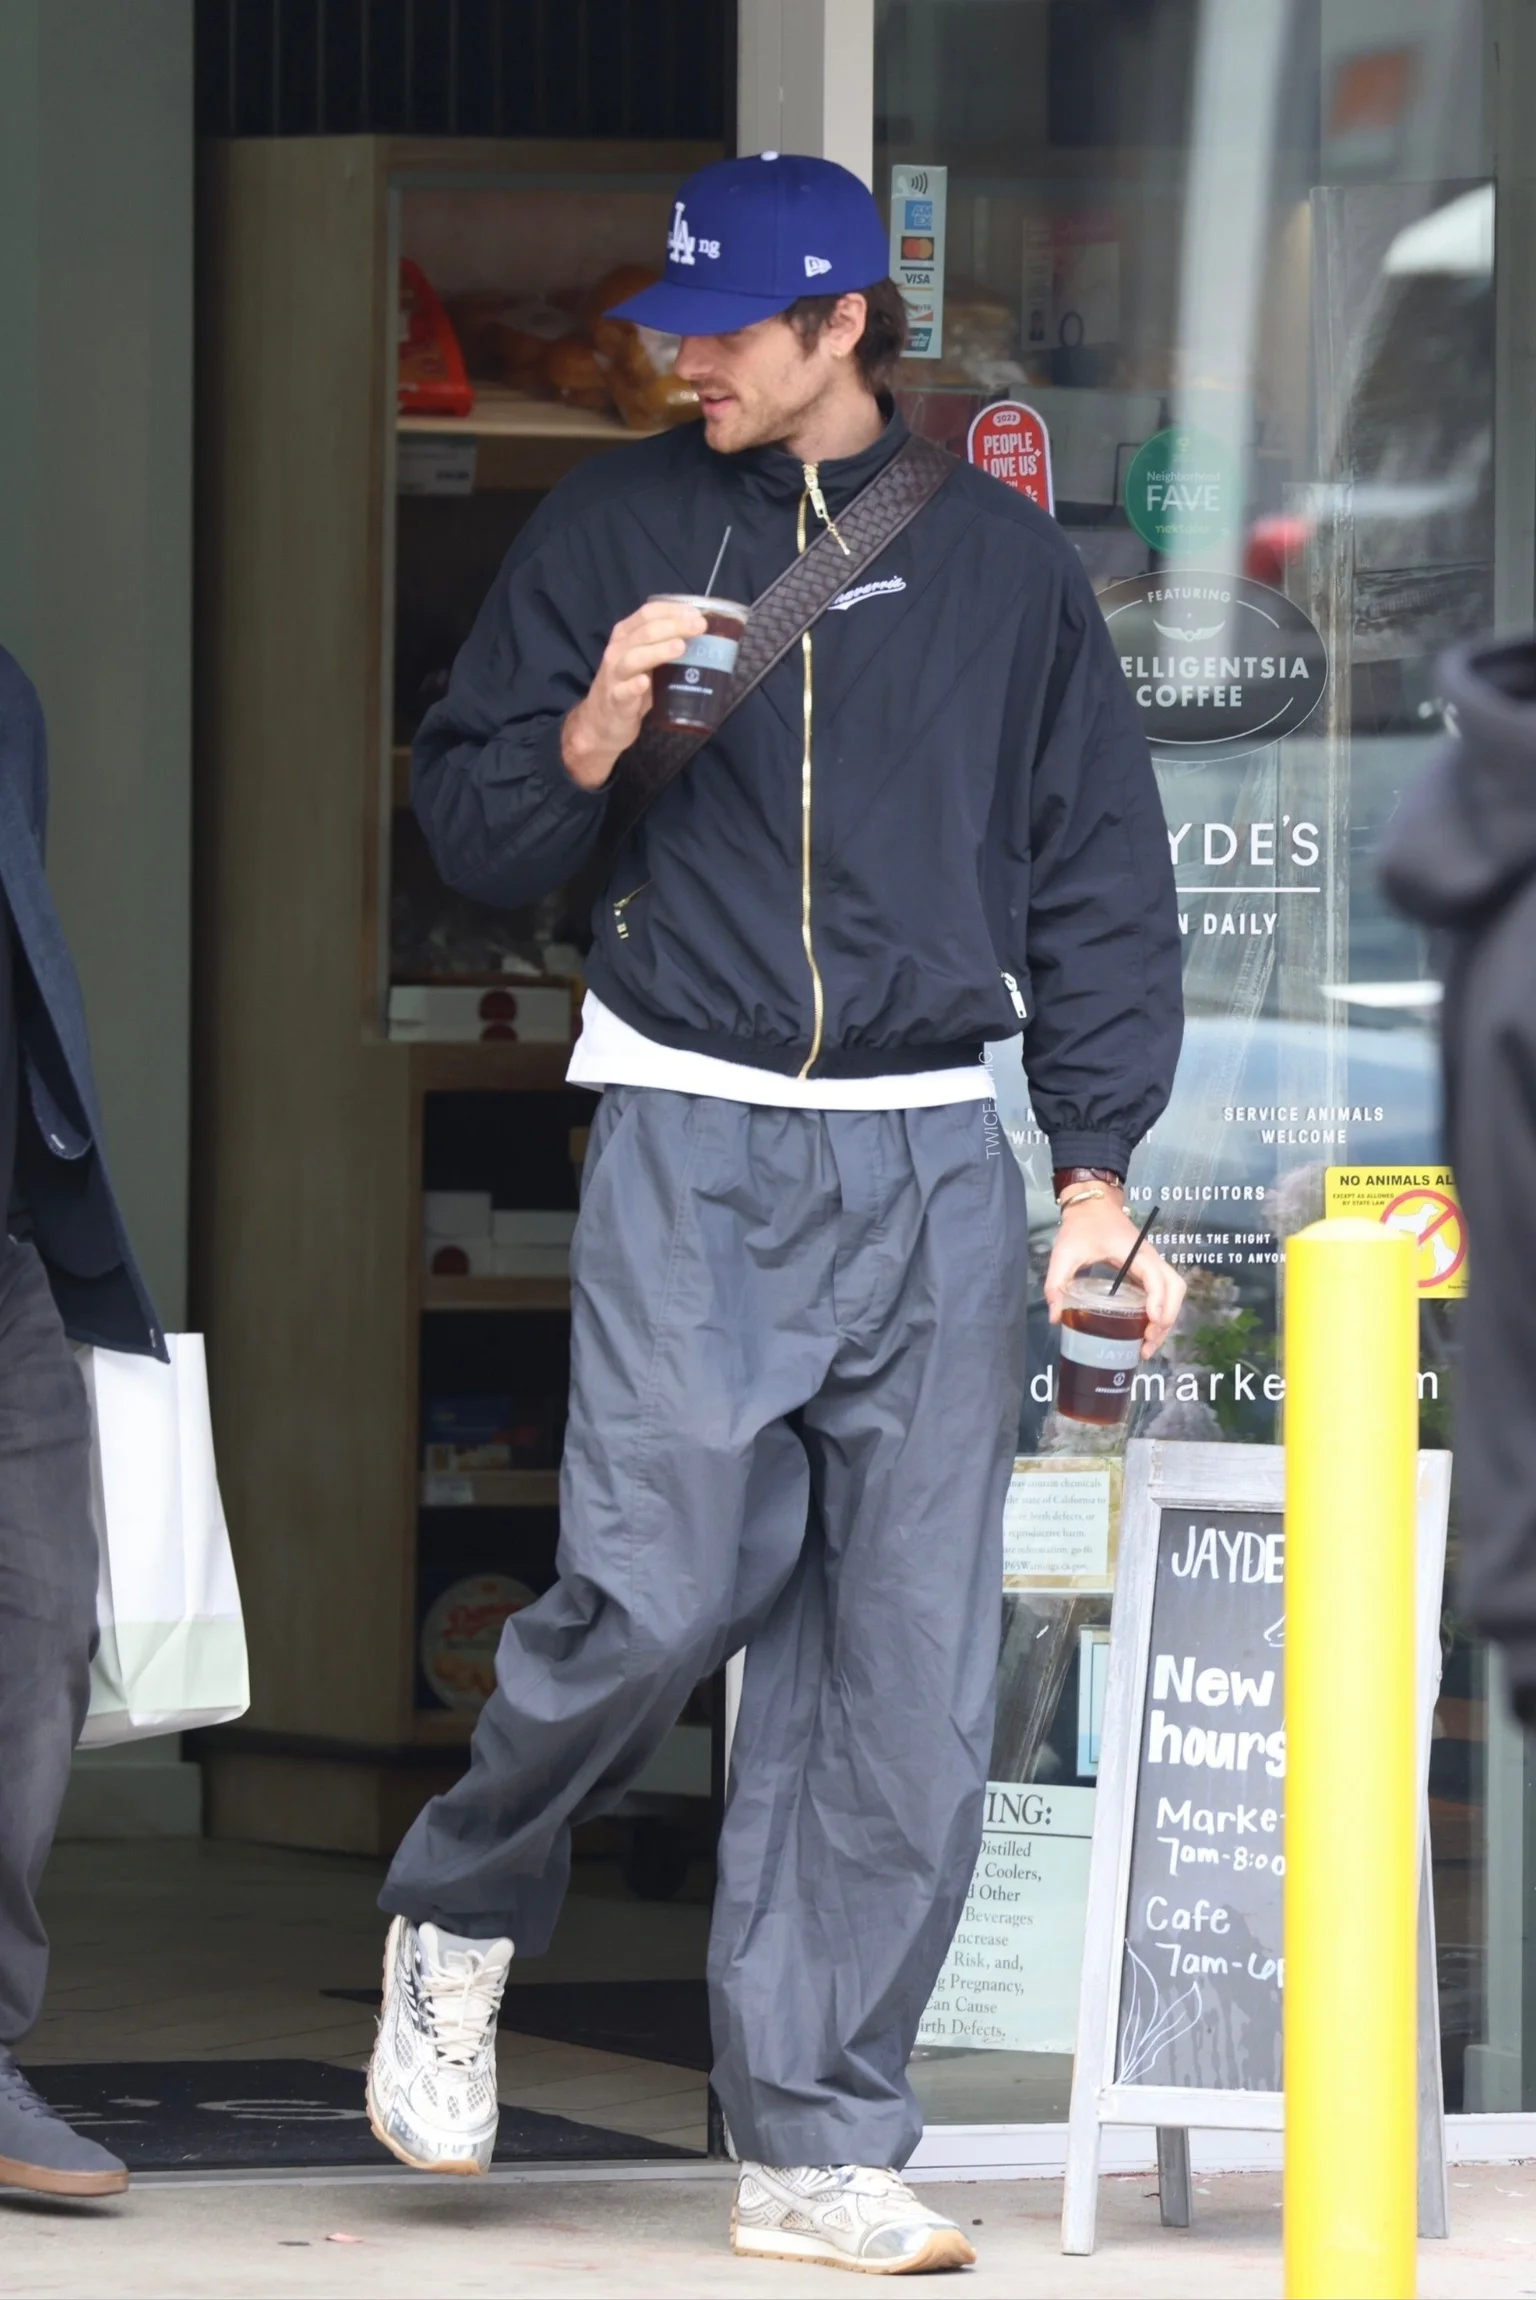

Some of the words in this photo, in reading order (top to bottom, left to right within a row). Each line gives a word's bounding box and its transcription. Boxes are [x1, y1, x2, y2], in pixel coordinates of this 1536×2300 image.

[905, 273, 931, 285] VISA
[996, 415, 1017, 423] 2023
[983, 432, 1034, 456] PEOPLE
[983, 457, 1017, 479] LOVE
[1018, 455, 1038, 477] US
[1146, 471, 1221, 484] Neighborhood
[1146, 485, 1221, 512] FAVE
[1147, 587, 1232, 604] FEATURING
[1120, 656, 1310, 679] ELLIGENTSIA
[1136, 685, 1242, 707] COFFEE
[1203, 913, 1278, 935] DAILY
[1223, 1107, 1298, 1122] SERVICE
[1305, 1107, 1384, 1122] ANIMALS
[1261, 1129, 1347, 1144] WELCOME
[1339, 1175, 1361, 1186] NO
[1365, 1175, 1430, 1186] ANIMALS
[1130, 1186, 1153, 1201] NO
[1160, 1186, 1265, 1201] SOLICITORS
[1147, 1234, 1202, 1245] RESERVE
[1206, 1234, 1230, 1245] THE
[1234, 1234, 1271, 1245] RIGHT
[1171, 1253, 1224, 1264] SERVICE
[1228, 1253, 1243, 1263] TO
[1060, 1477, 1102, 1488] chemicals
[1042, 1494, 1053, 1504] of
[1053, 1493, 1095, 1504] California
[1097, 1496, 1106, 1504] to
[1052, 1510, 1084, 1522] defects,
[1008, 1528, 1061, 1541] reproductive
[1171, 1525, 1285, 1584] JAYDE
[1152, 1654, 1275, 1707] New
[1147, 1710, 1287, 1778] hours
[984, 1862, 1042, 1882] Coolers,
[979, 1884, 1021, 1903] Other
[965, 1905, 1034, 1928] Beverages
[1145, 1896, 1230, 1934] Cafe
[953, 1951, 990, 1970] Risk,
[994, 1953, 1024, 1972] and,
[950, 1973, 1025, 1996] Pregnancy,
[955, 1996, 998, 2014] Cause
[951, 2019, 1007, 2038] Defects.
